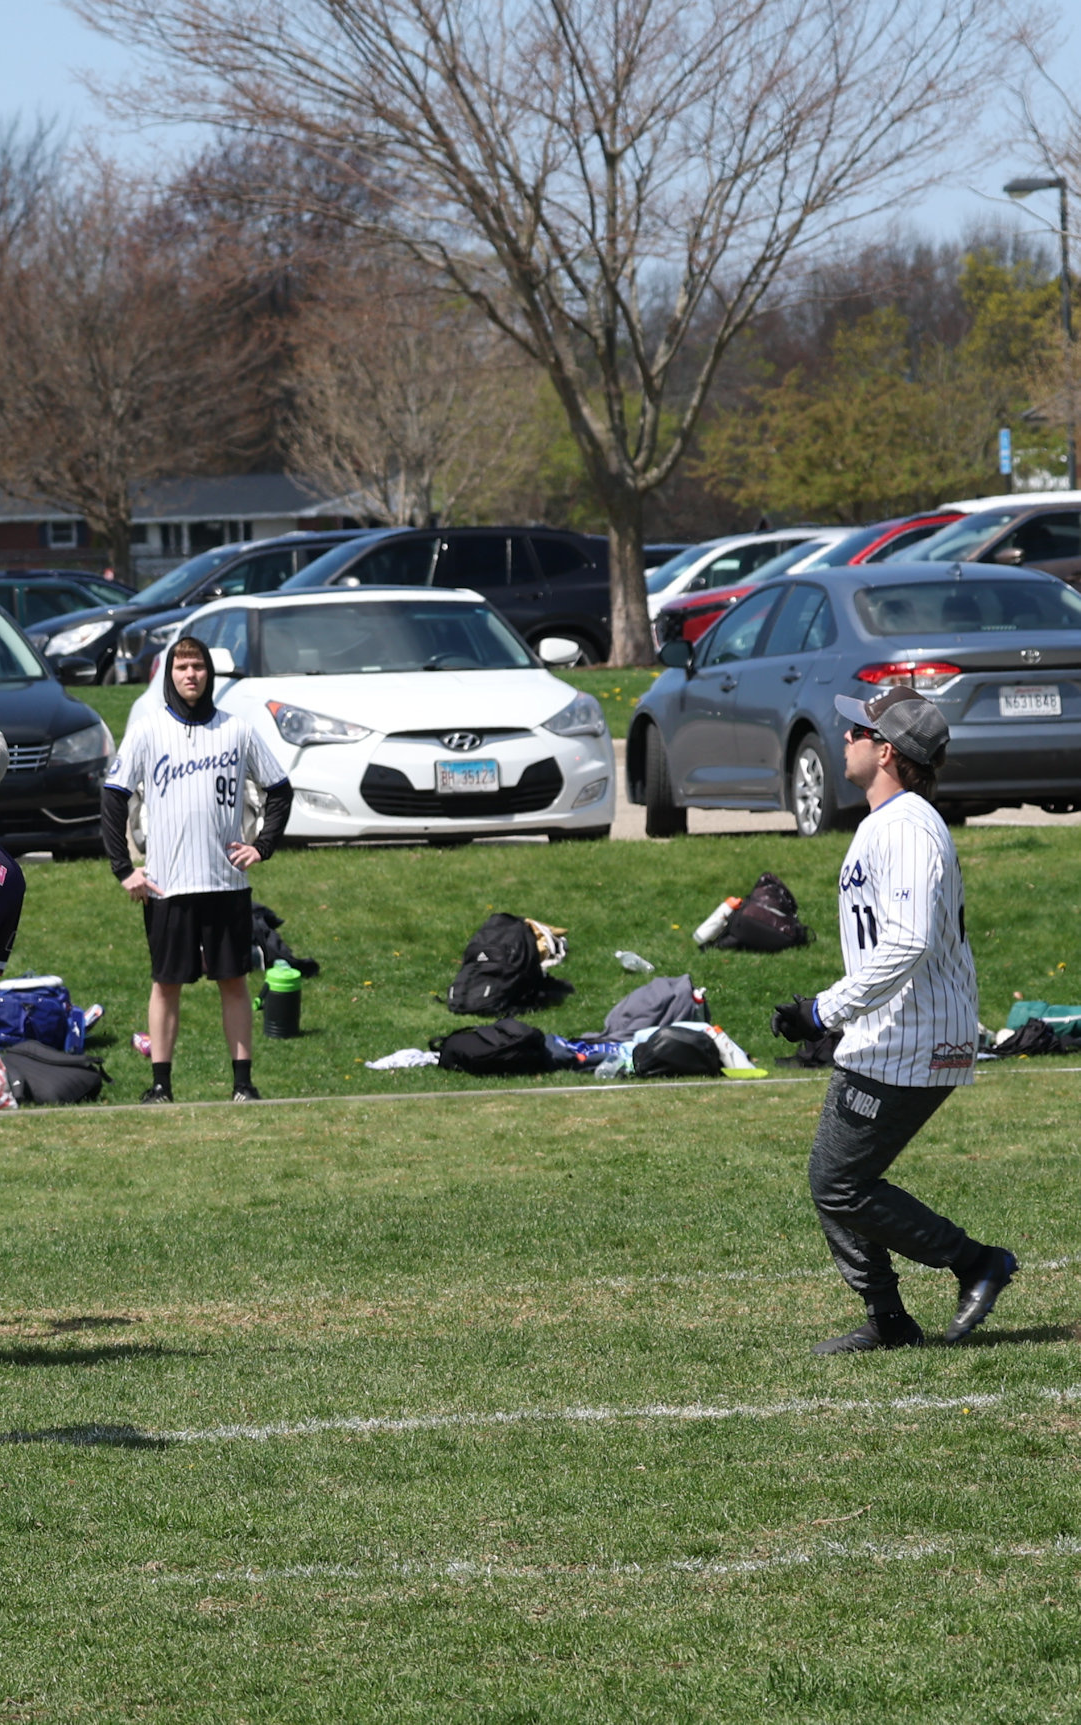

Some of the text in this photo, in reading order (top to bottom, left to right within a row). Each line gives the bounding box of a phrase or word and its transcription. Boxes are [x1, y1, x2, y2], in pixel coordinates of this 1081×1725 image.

[153, 747, 240, 798] Gnomes
[215, 775, 238, 808] 99
[839, 861, 868, 895] es
[852, 904, 878, 950] 11
[850, 1089, 882, 1120] NBA
